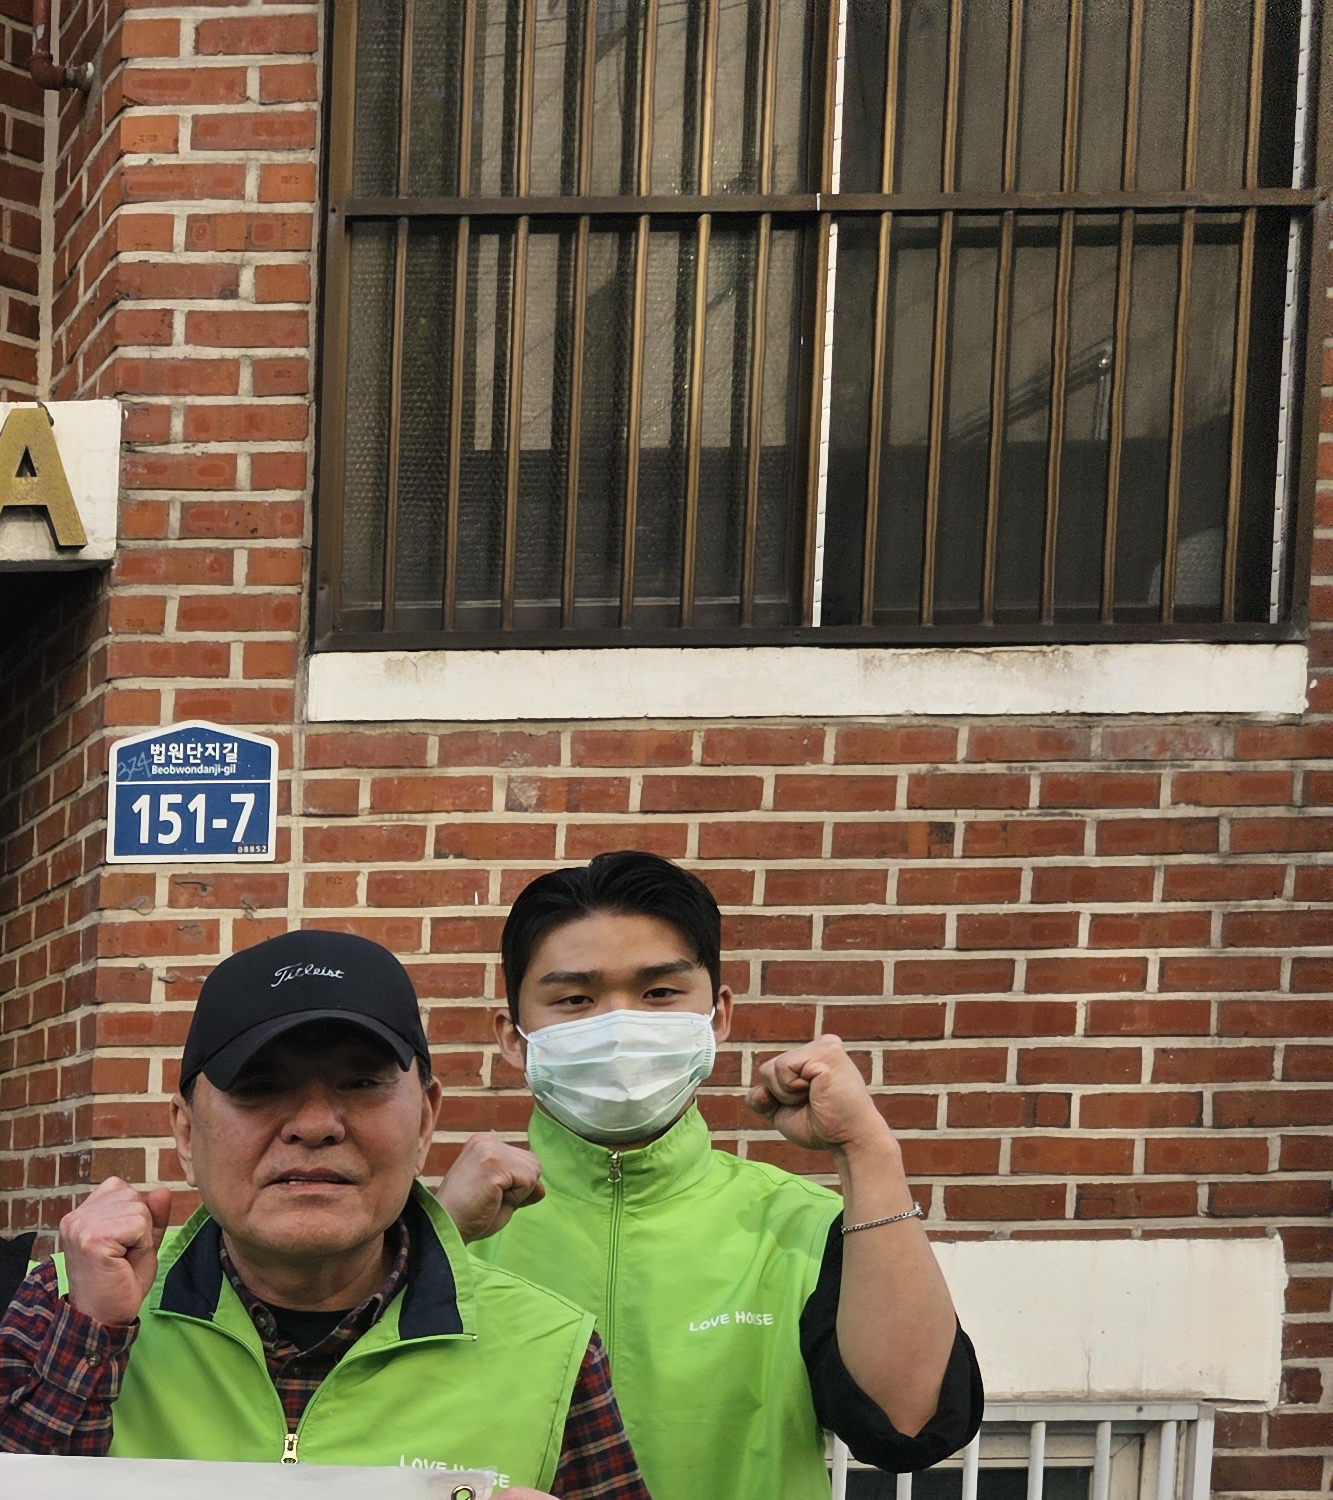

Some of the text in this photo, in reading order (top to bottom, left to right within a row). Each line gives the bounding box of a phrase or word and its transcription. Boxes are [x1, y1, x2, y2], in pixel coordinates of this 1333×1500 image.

[150, 742, 239, 764] 법원단지길
[151, 764, 237, 777] Beobwondanji-gil
[131, 792, 256, 845] 151-7
[270, 962, 345, 988] Titleist
[689, 1313, 731, 1332] LOVE
